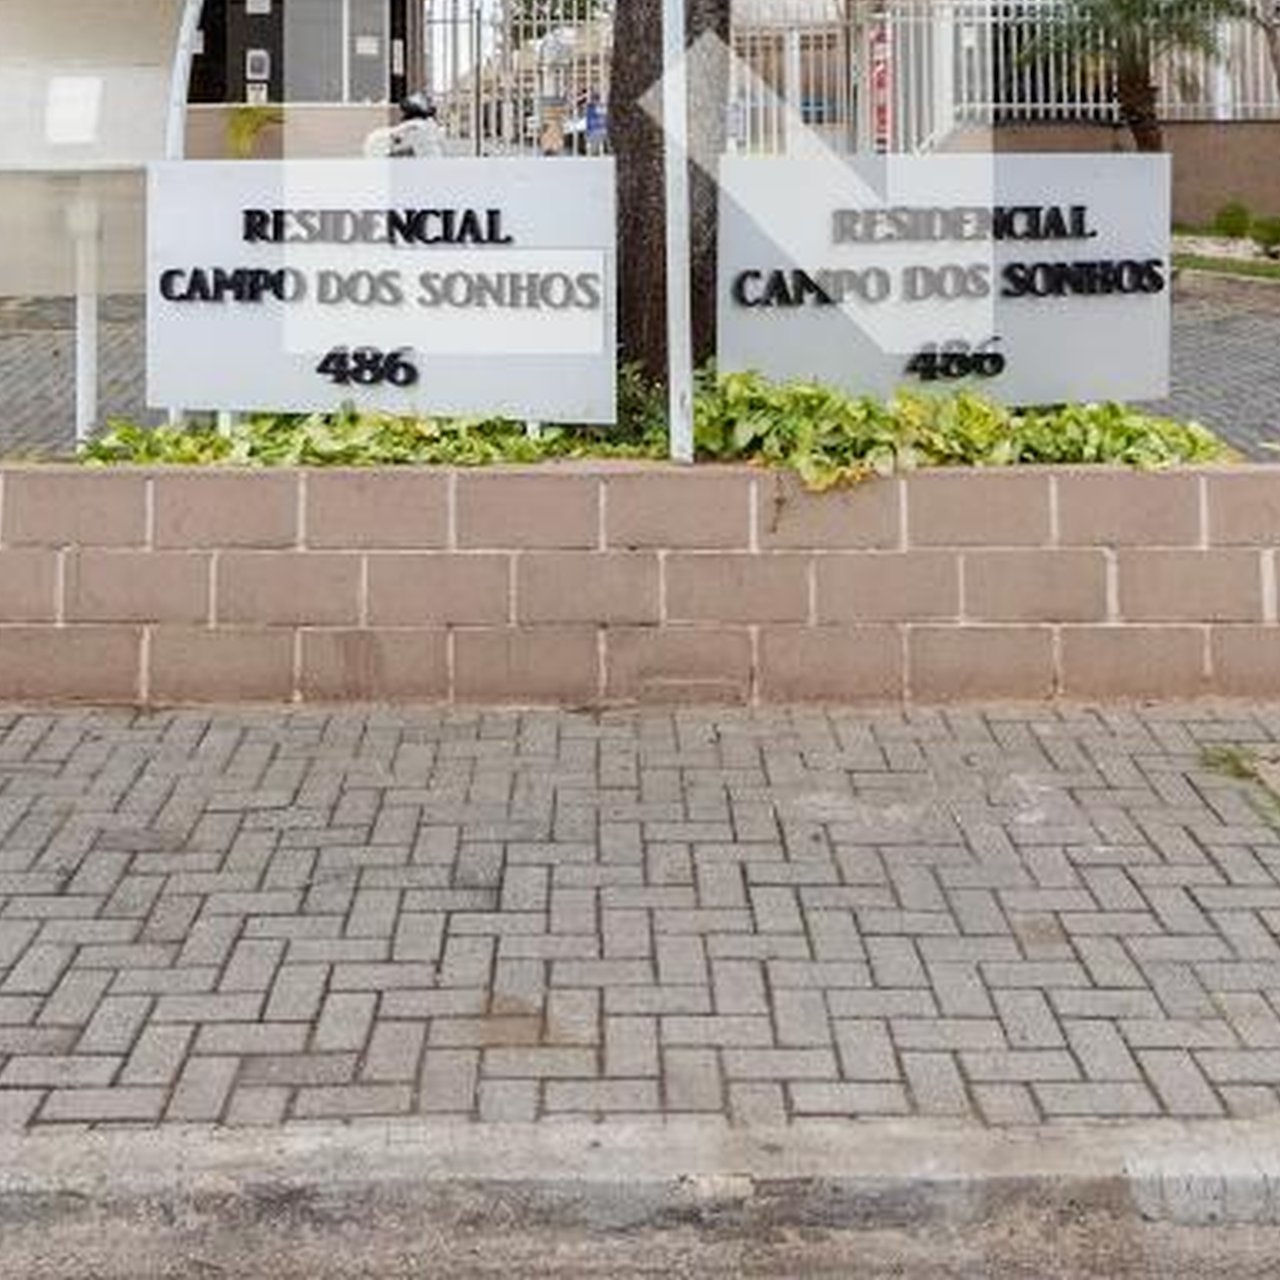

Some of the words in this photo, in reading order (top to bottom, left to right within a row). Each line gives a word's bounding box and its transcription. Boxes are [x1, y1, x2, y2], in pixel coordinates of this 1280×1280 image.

[242, 209, 512, 245] RESIDENCIAL
[832, 206, 1098, 243] RESIDENCIAL
[158, 268, 307, 303] CAMPO
[316, 271, 404, 307] DOS
[418, 272, 601, 310] SONHOS
[732, 269, 890, 307] CAMPO
[902, 265, 990, 302] DOS
[1001, 259, 1166, 299] SONHOS
[316, 345, 419, 387] 486
[904, 337, 1007, 381] 486
